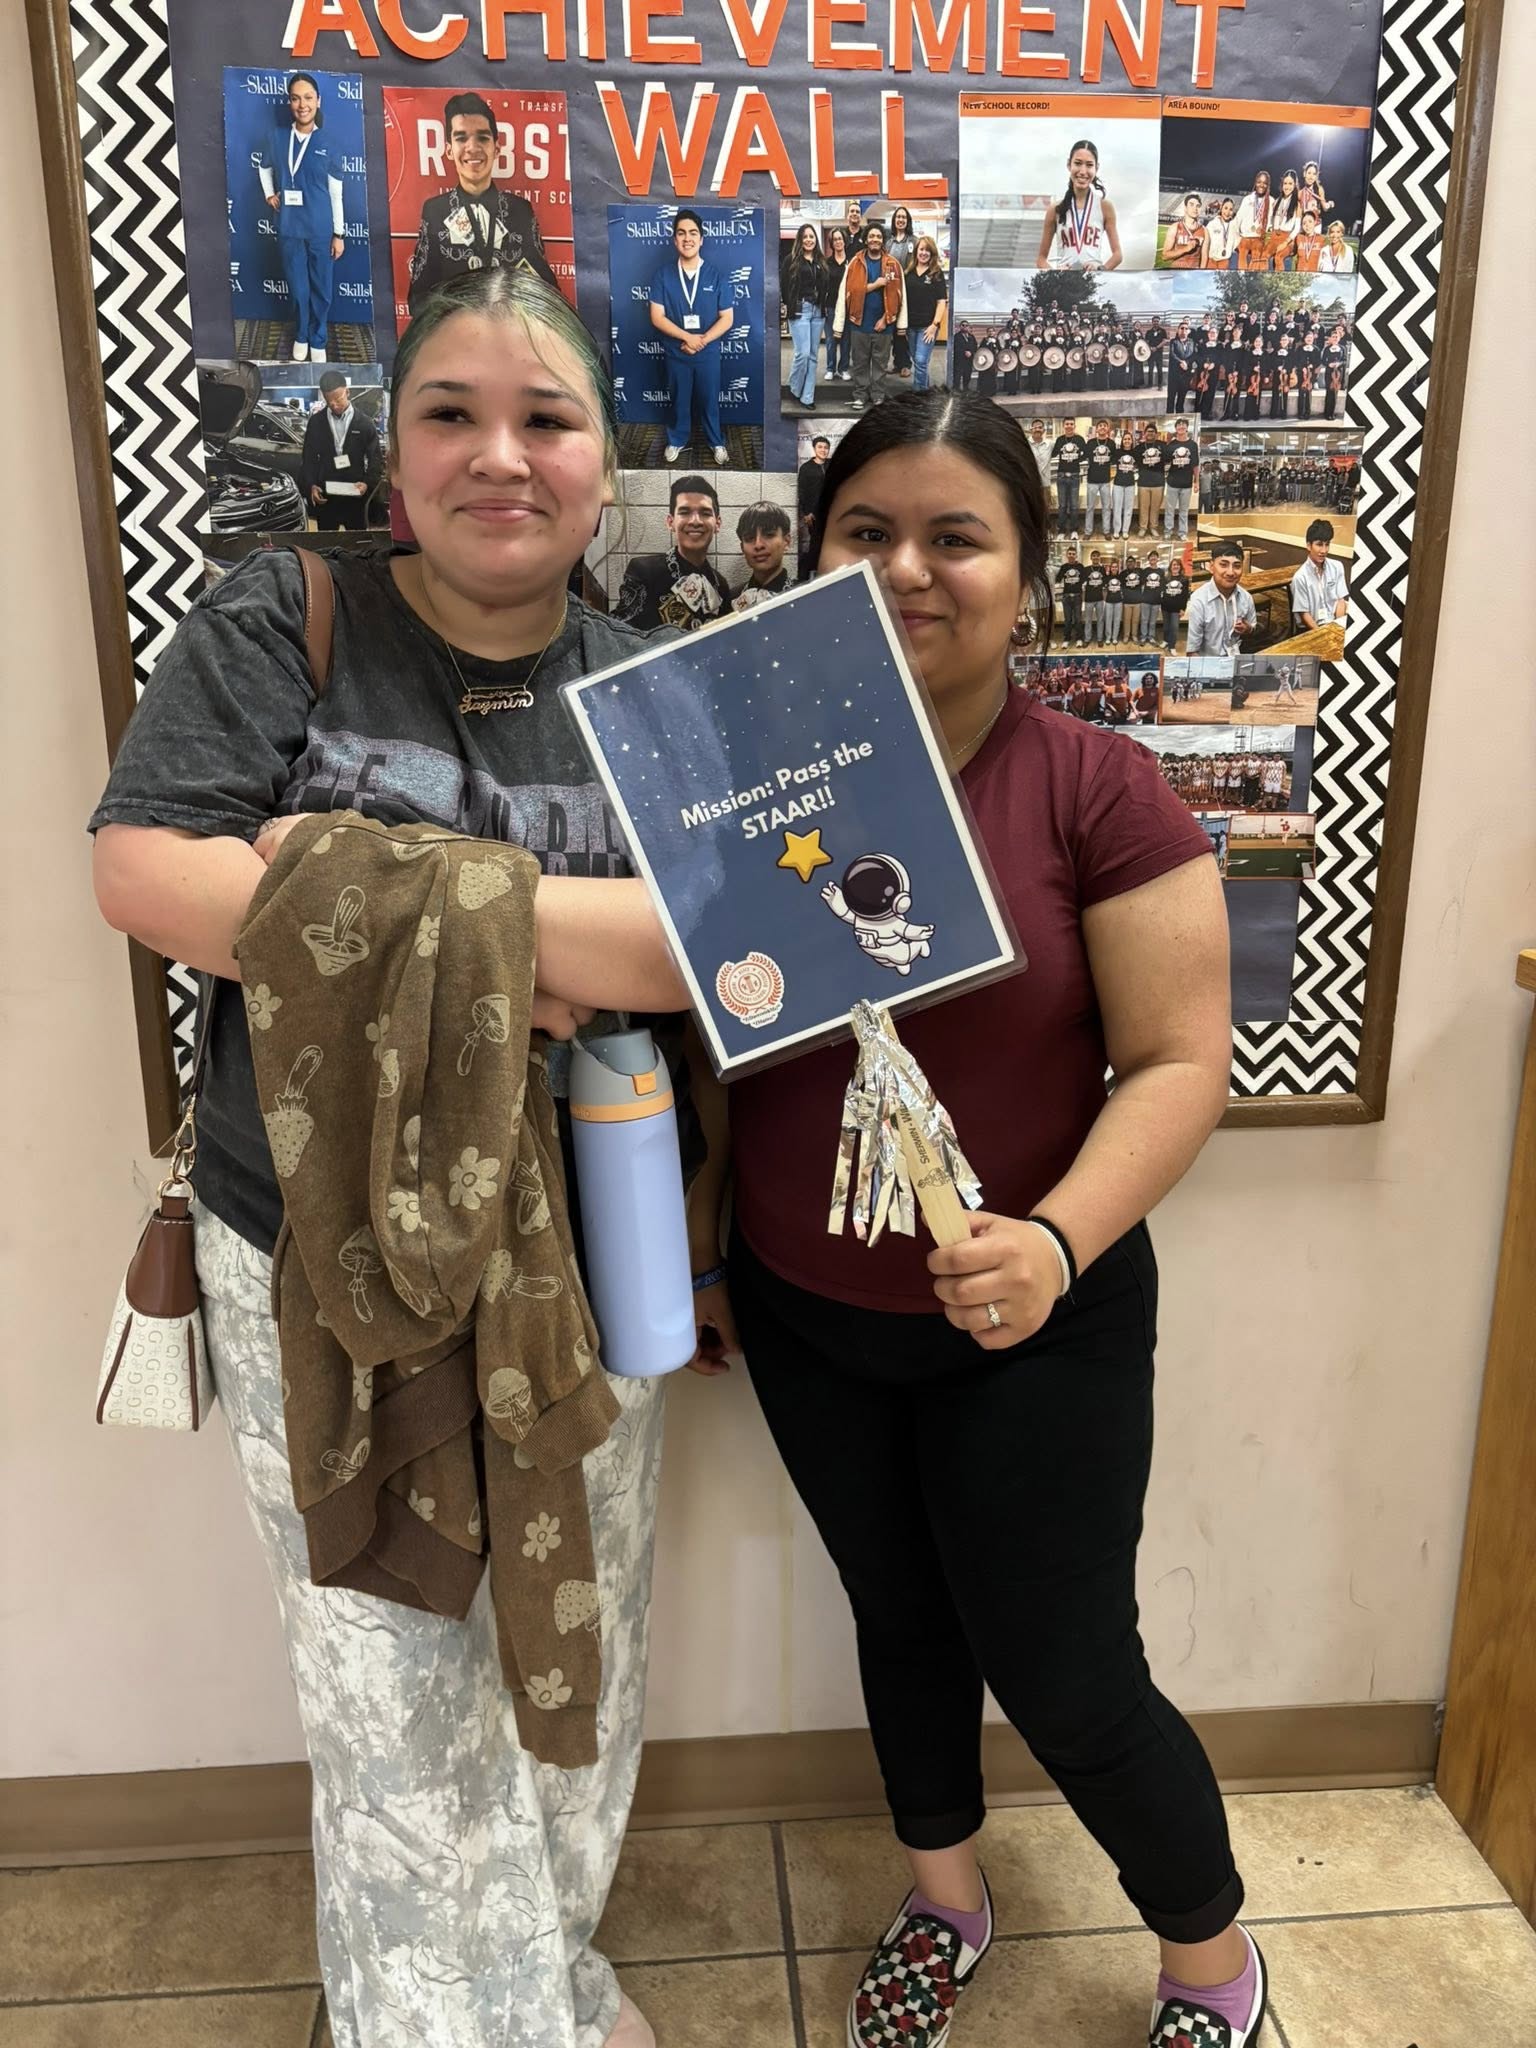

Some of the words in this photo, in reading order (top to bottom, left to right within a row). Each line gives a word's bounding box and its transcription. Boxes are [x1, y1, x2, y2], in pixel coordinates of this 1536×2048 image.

[282, 0, 1246, 88] ACHIEVEMENT
[982, 101, 1015, 110] SCHOOL
[1016, 101, 1050, 110] RECORD!
[1168, 101, 1188, 110] AREA
[1189, 102, 1221, 111] BOUND!
[596, 81, 949, 200] WALL
[1060, 226, 1101, 249] ALCE
[680, 781, 775, 830] Mission:
[775, 758, 832, 791] Pass
[833, 741, 874, 767] the
[741, 785, 836, 840] STAAR!!
